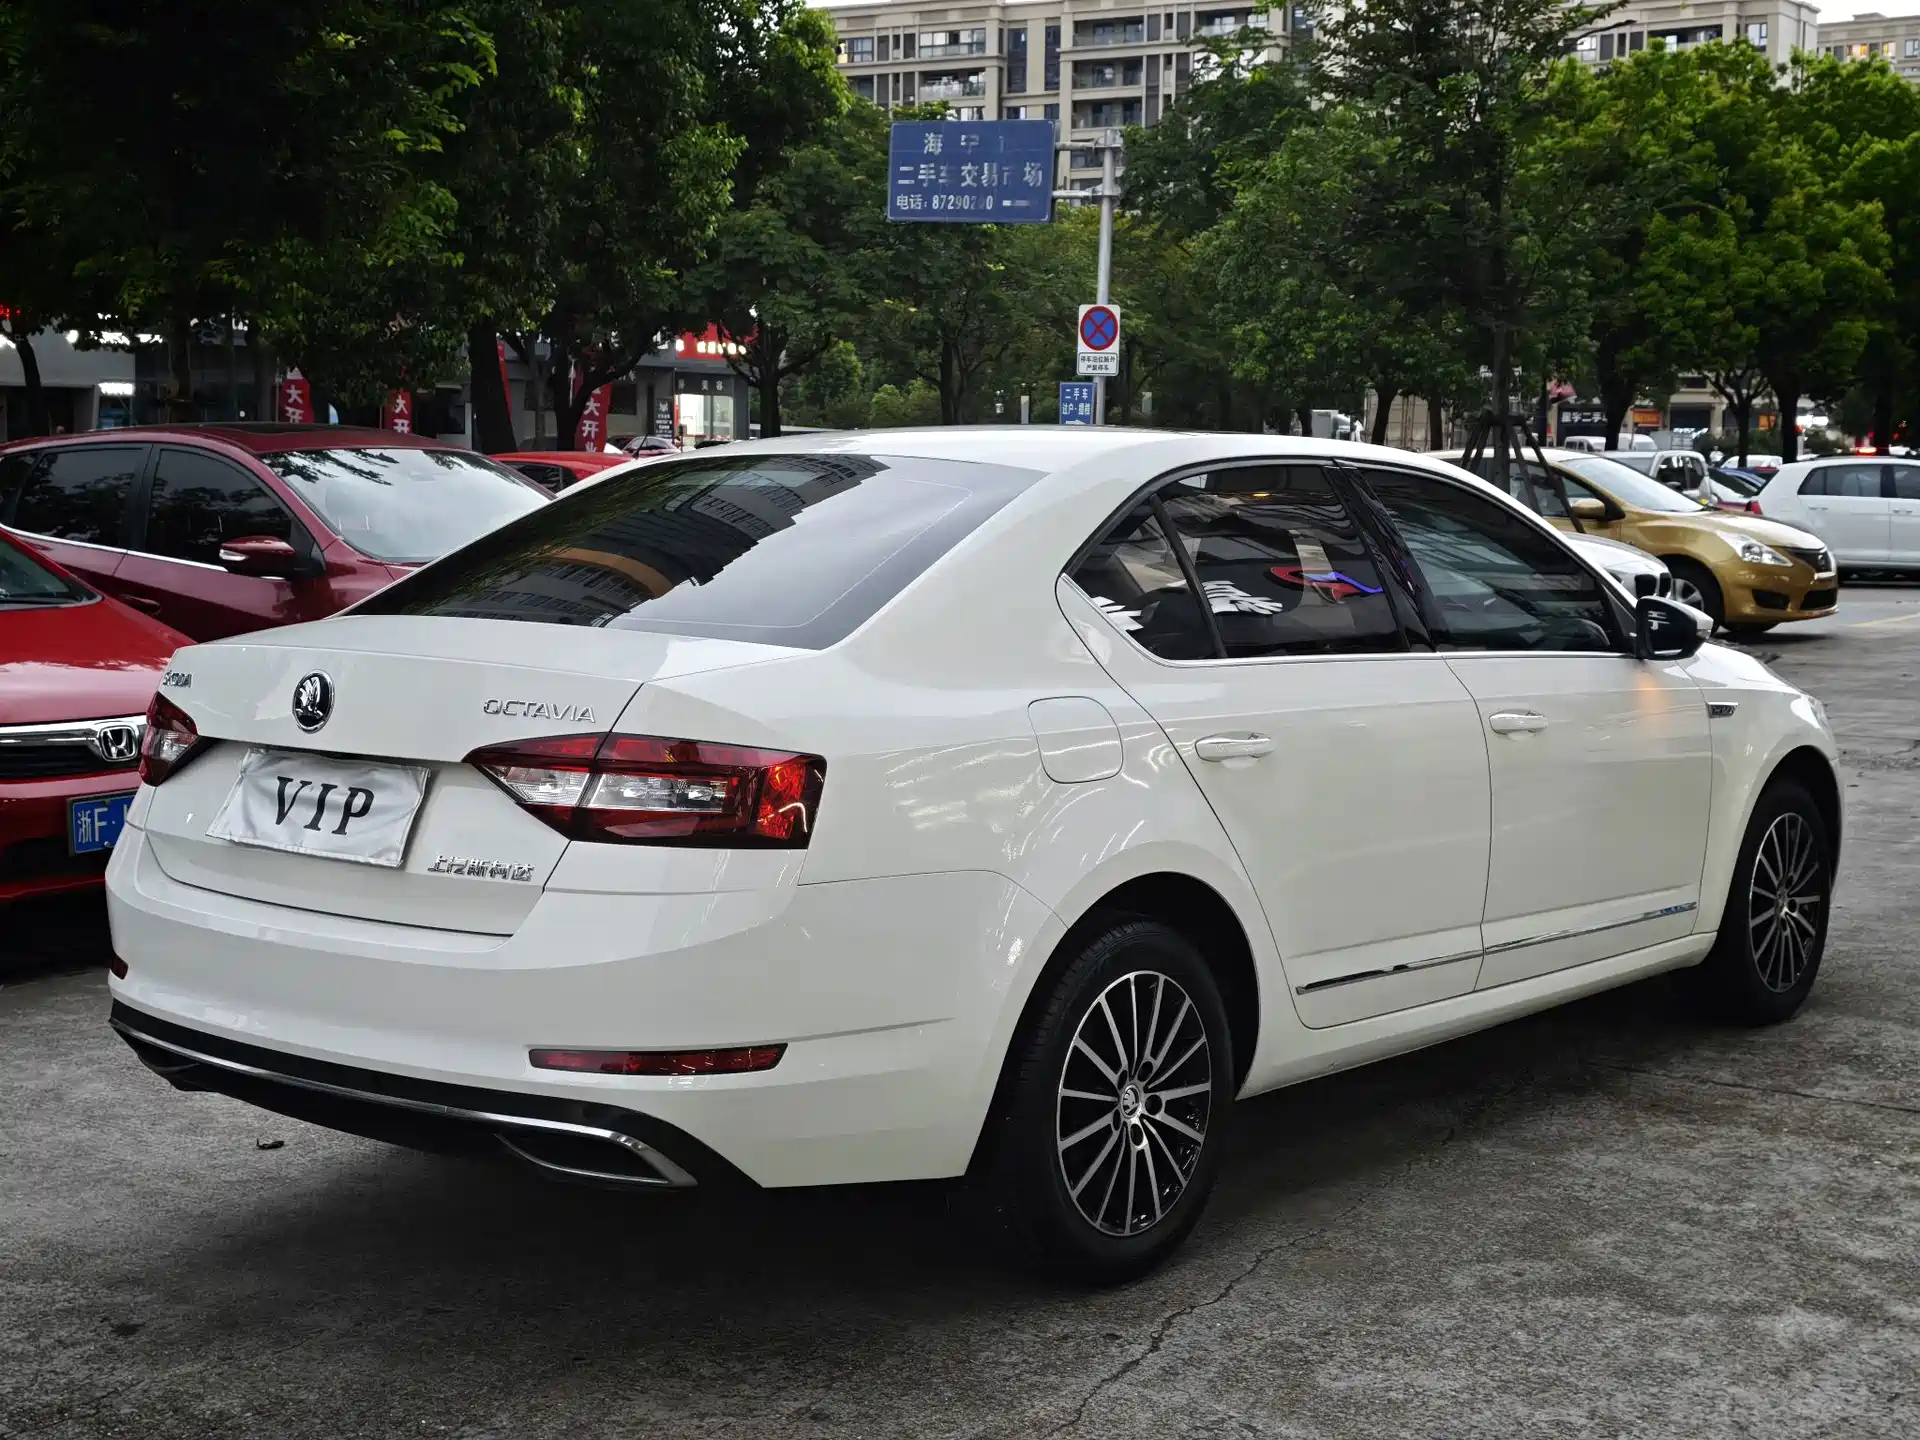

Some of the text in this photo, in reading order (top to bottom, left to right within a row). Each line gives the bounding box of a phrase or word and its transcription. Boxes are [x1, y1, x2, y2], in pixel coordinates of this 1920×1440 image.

[484, 698, 596, 723] OCTAVIA
[275, 775, 375, 836] VIP
[77, 805, 129, 844] 浙F·
[427, 854, 536, 882] 上汽斯柯达
